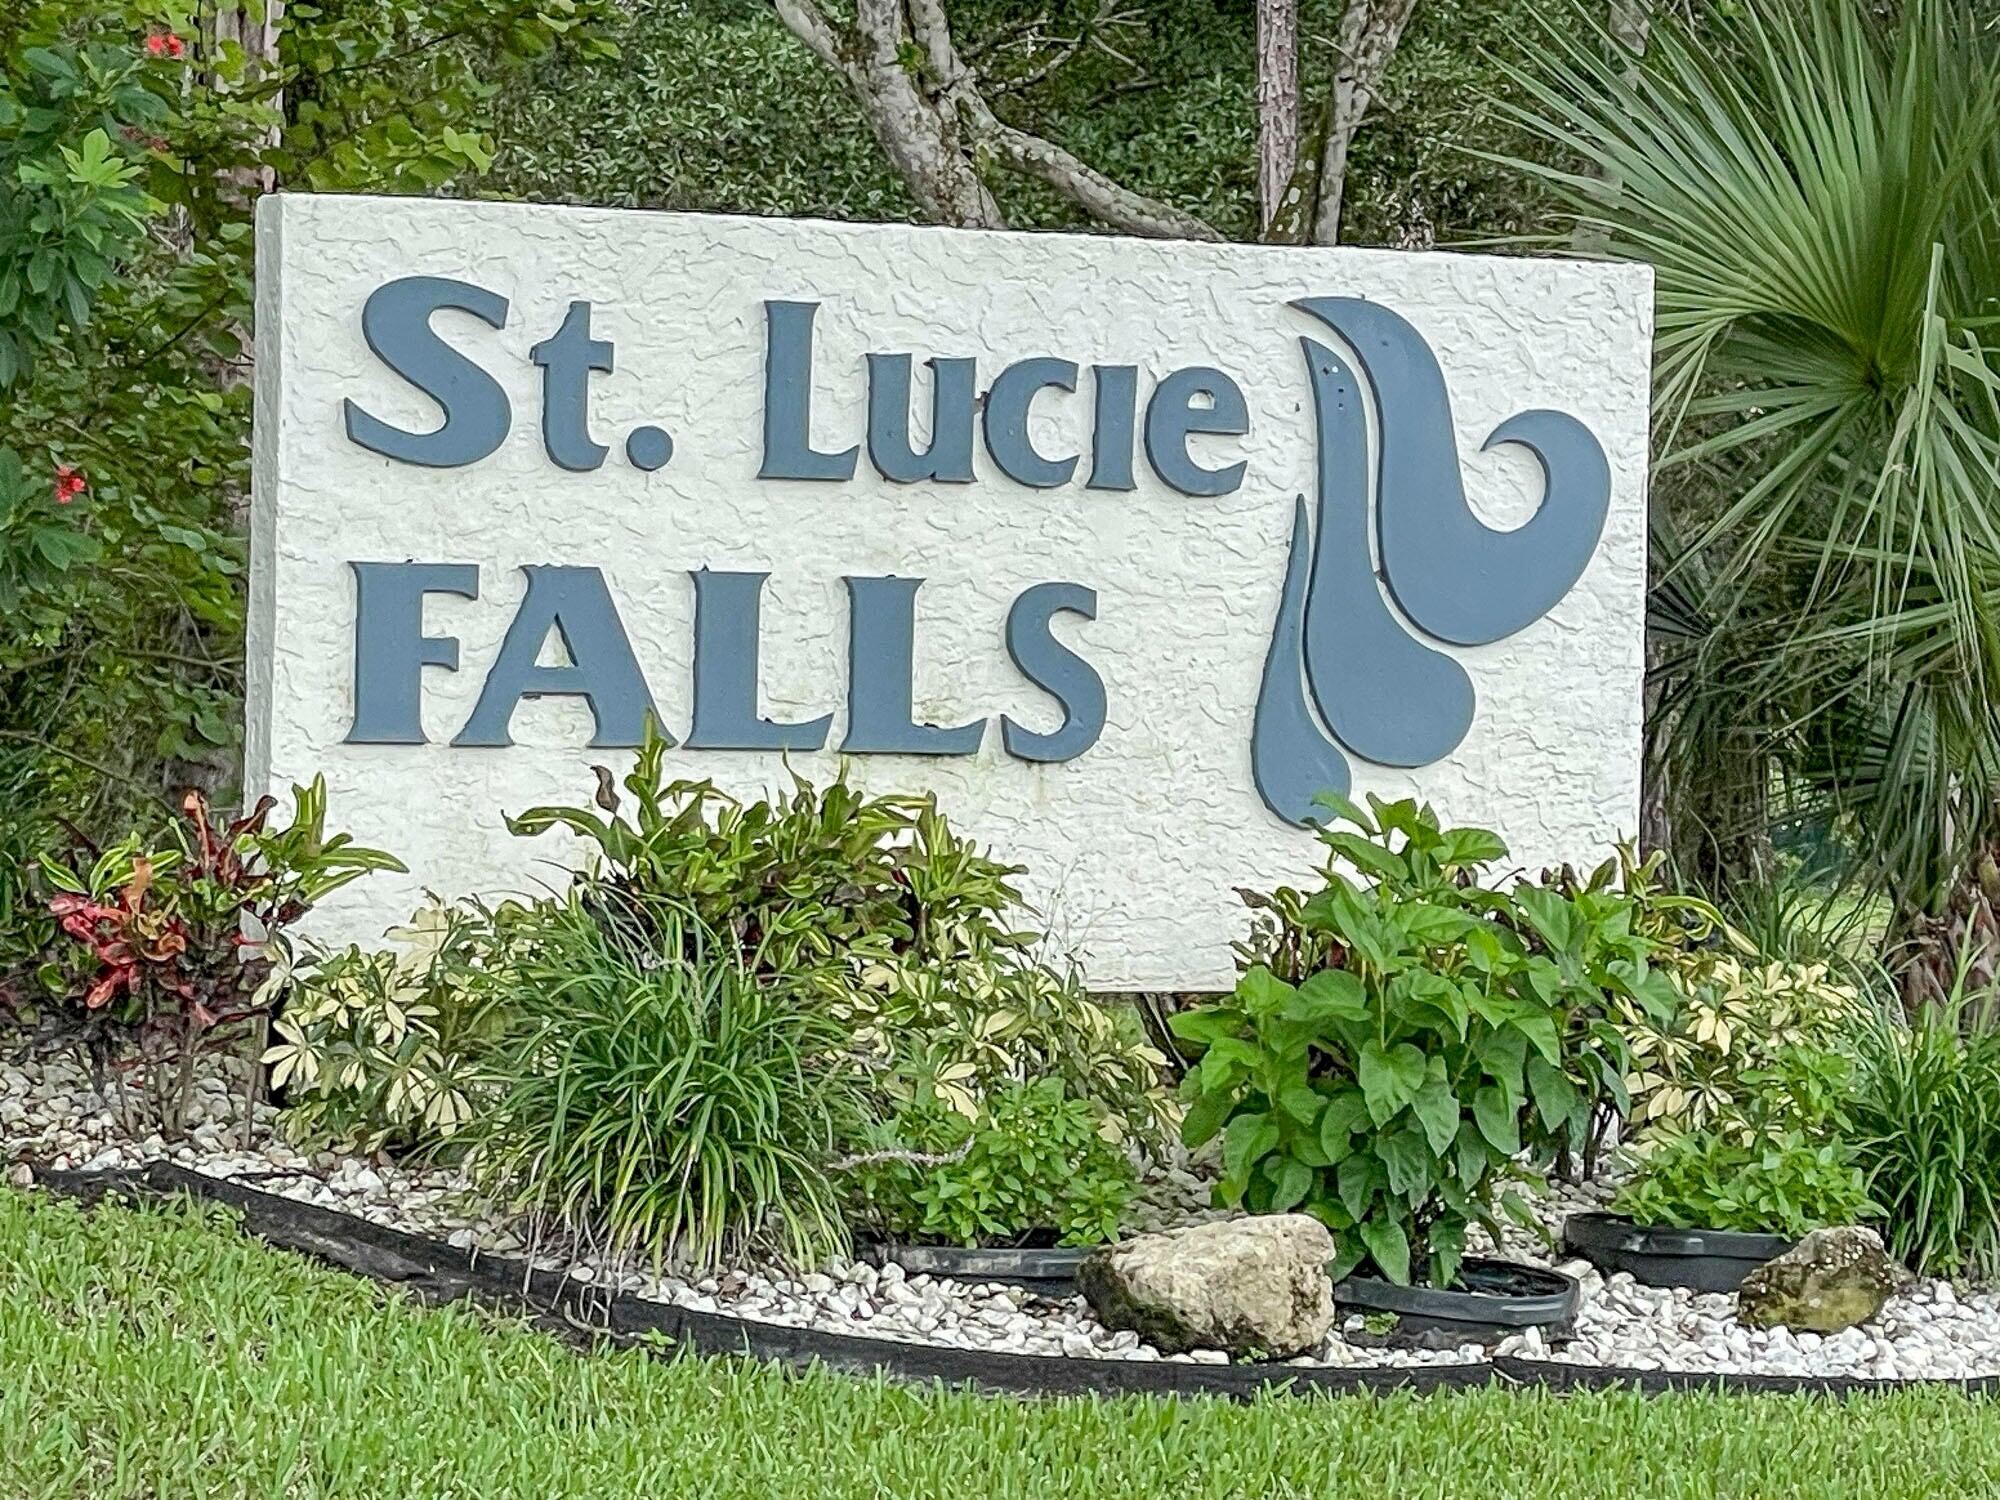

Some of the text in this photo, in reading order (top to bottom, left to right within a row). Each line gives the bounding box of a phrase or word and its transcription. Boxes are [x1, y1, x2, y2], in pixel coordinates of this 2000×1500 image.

[344, 276, 1249, 497] St. Lucie
[343, 560, 1107, 763] FALLS
